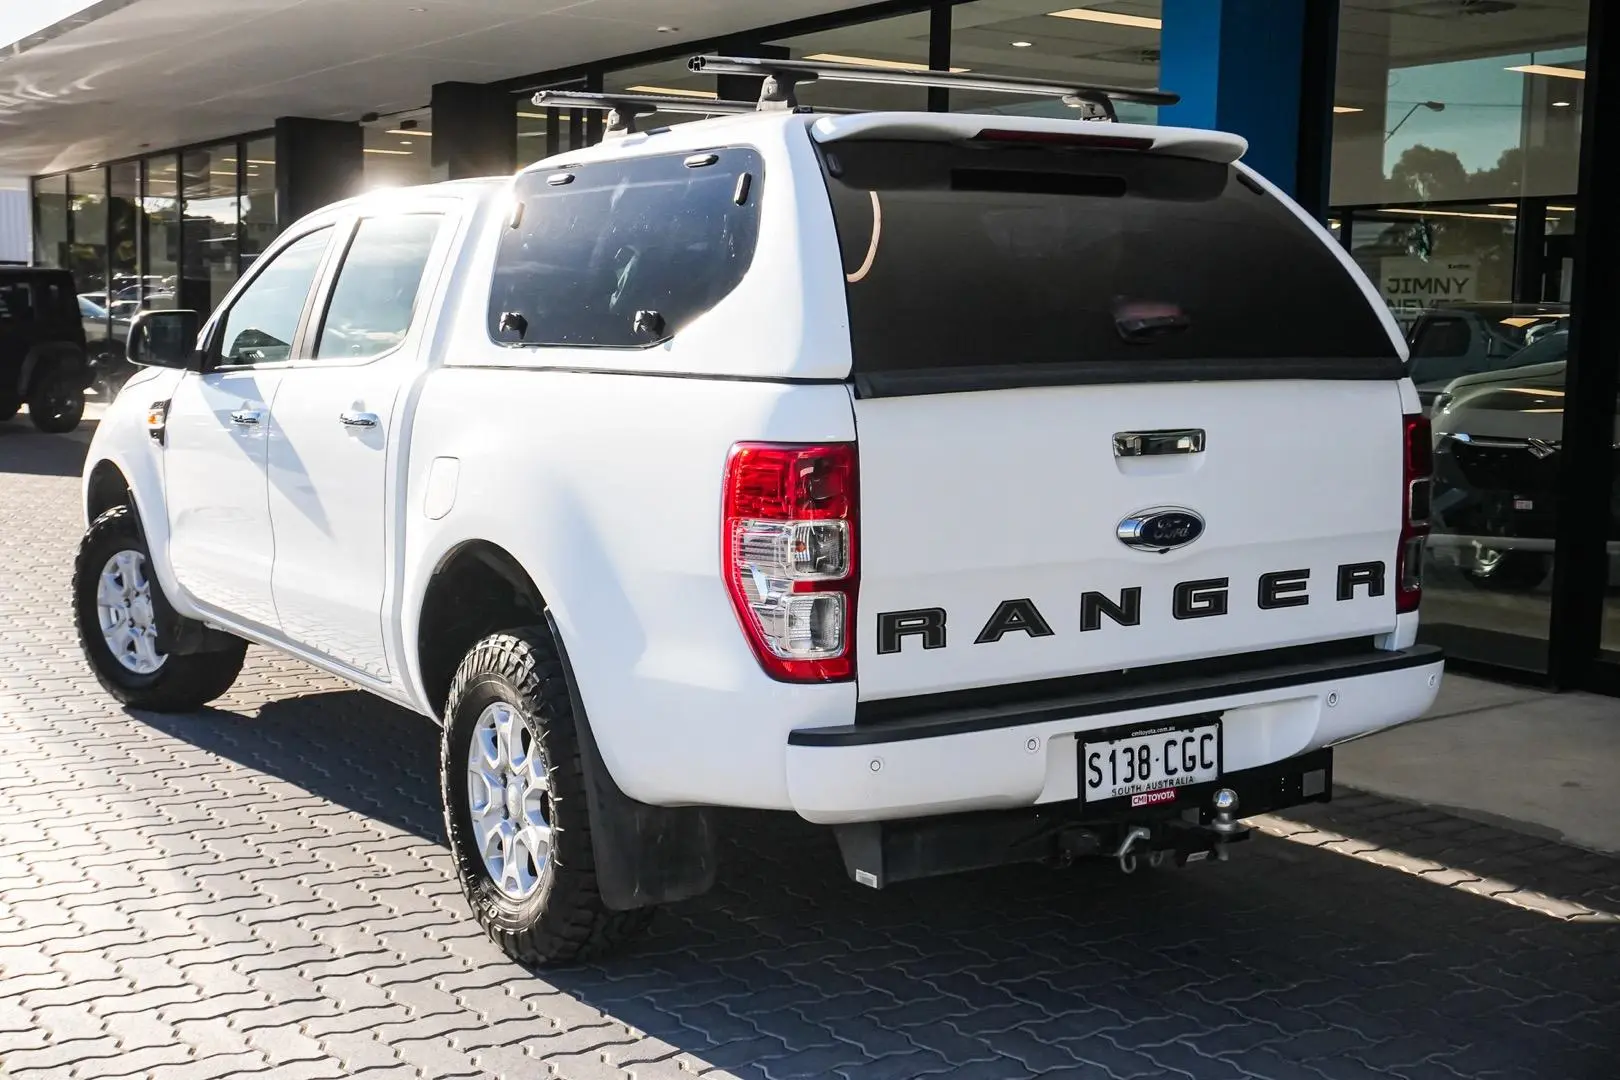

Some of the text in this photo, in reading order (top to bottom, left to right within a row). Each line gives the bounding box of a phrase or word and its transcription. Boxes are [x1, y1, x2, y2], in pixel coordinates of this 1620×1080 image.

[1387, 278, 1469, 294] JIMNY
[877, 560, 1385, 655] RANGER
[1131, 726, 1175, 736] cmitoyota.com.au
[1111, 776, 1194, 796] SOUTH AUSTRALIA
[1133, 790, 1176, 805] CMI TOYOTA
